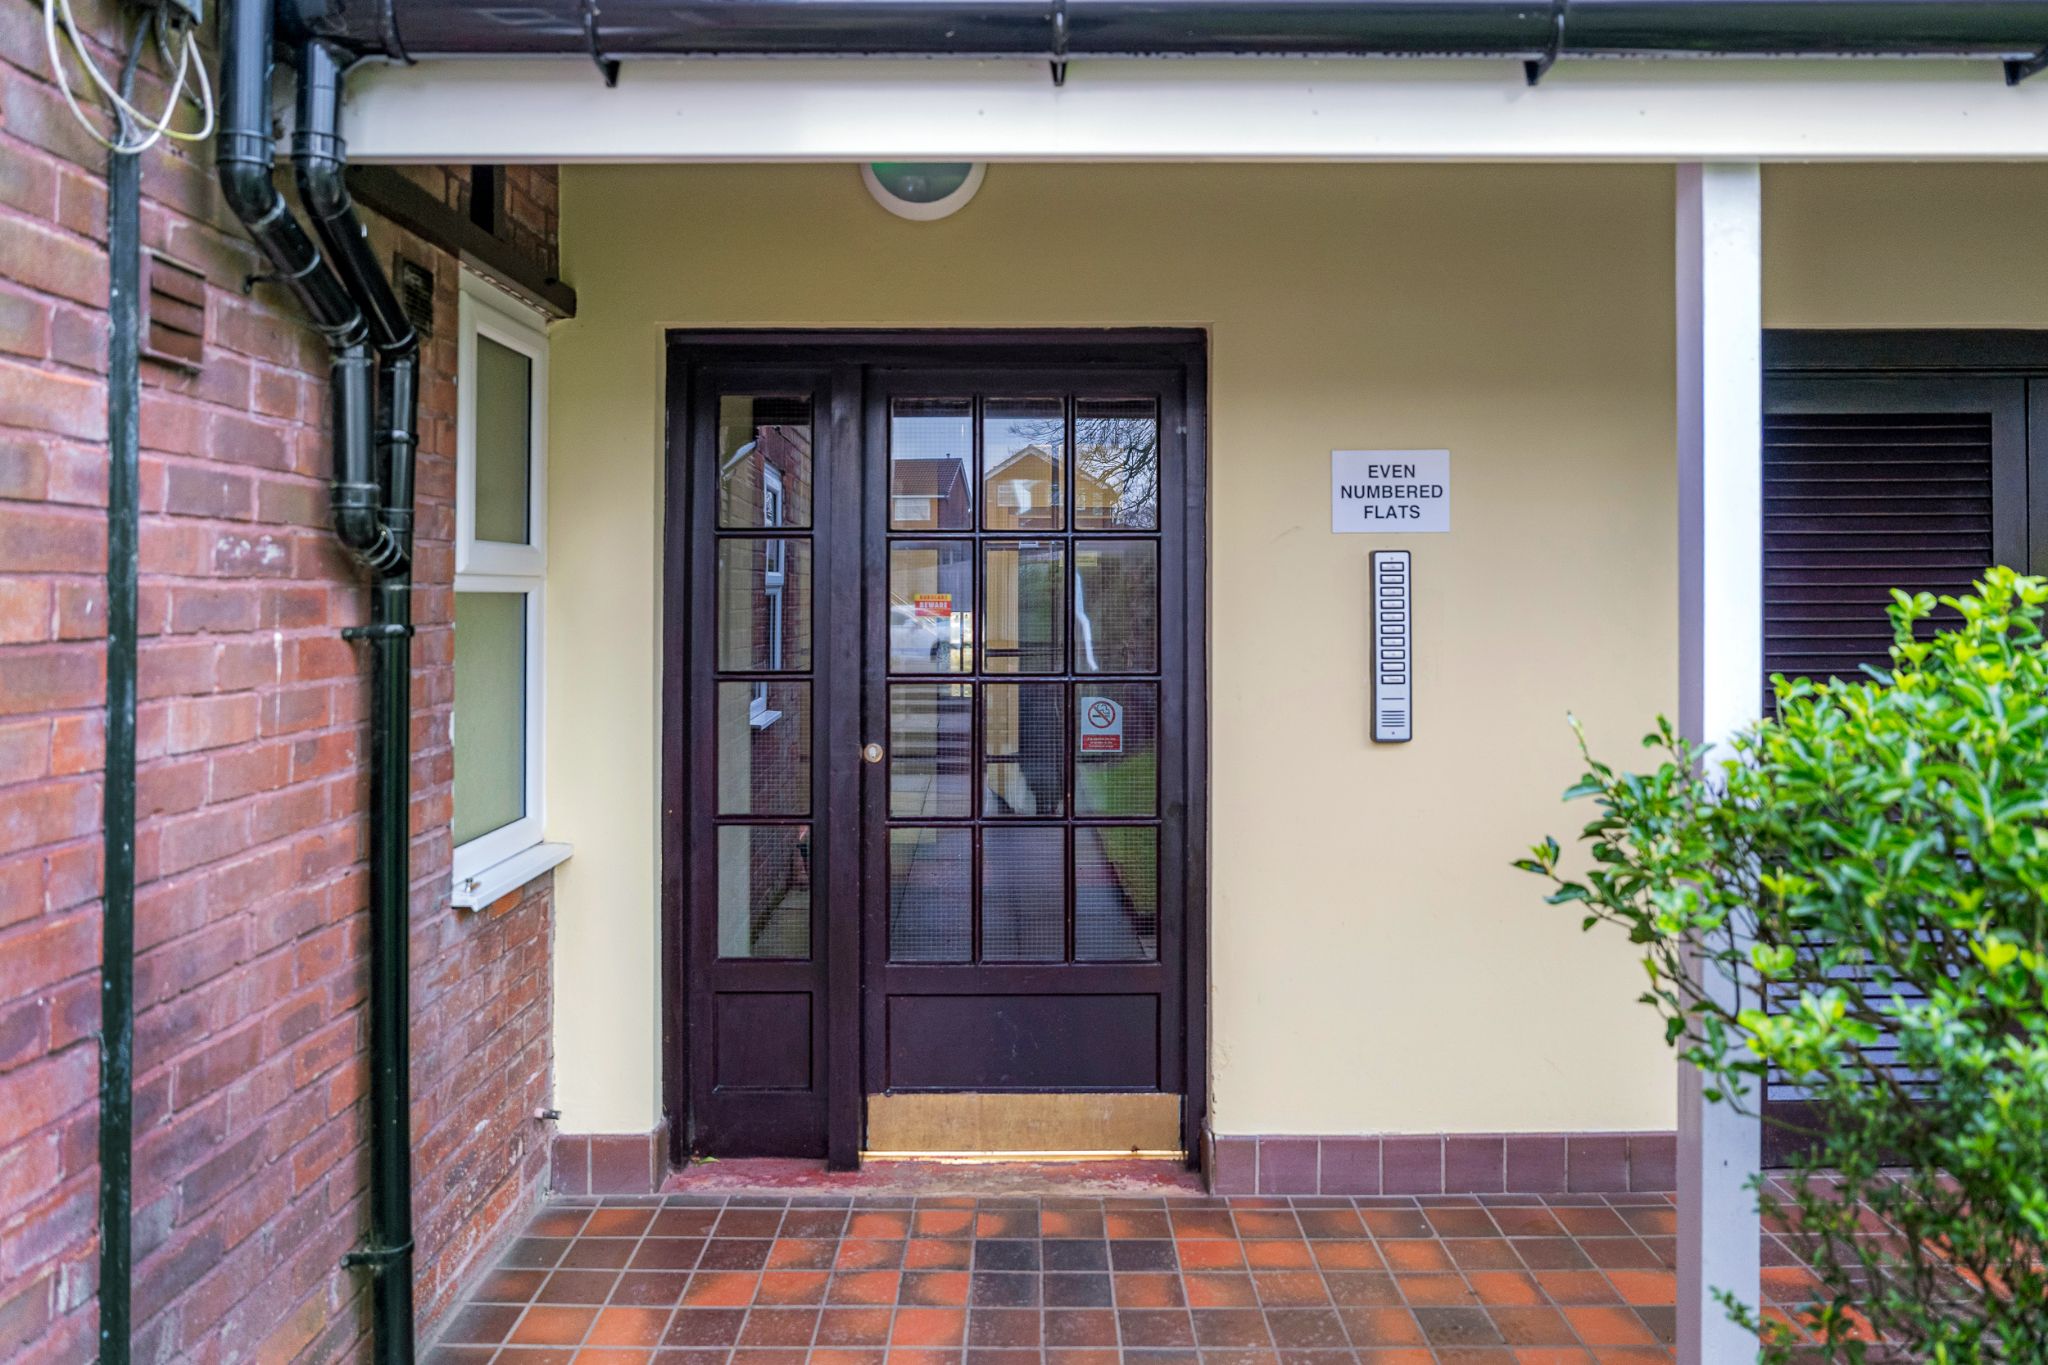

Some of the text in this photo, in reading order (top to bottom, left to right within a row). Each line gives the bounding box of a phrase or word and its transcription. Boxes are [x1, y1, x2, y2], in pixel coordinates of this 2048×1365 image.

[1368, 464, 1415, 478] EVEN
[1341, 485, 1443, 499] NUMBERED
[1364, 505, 1421, 519] FLATS
